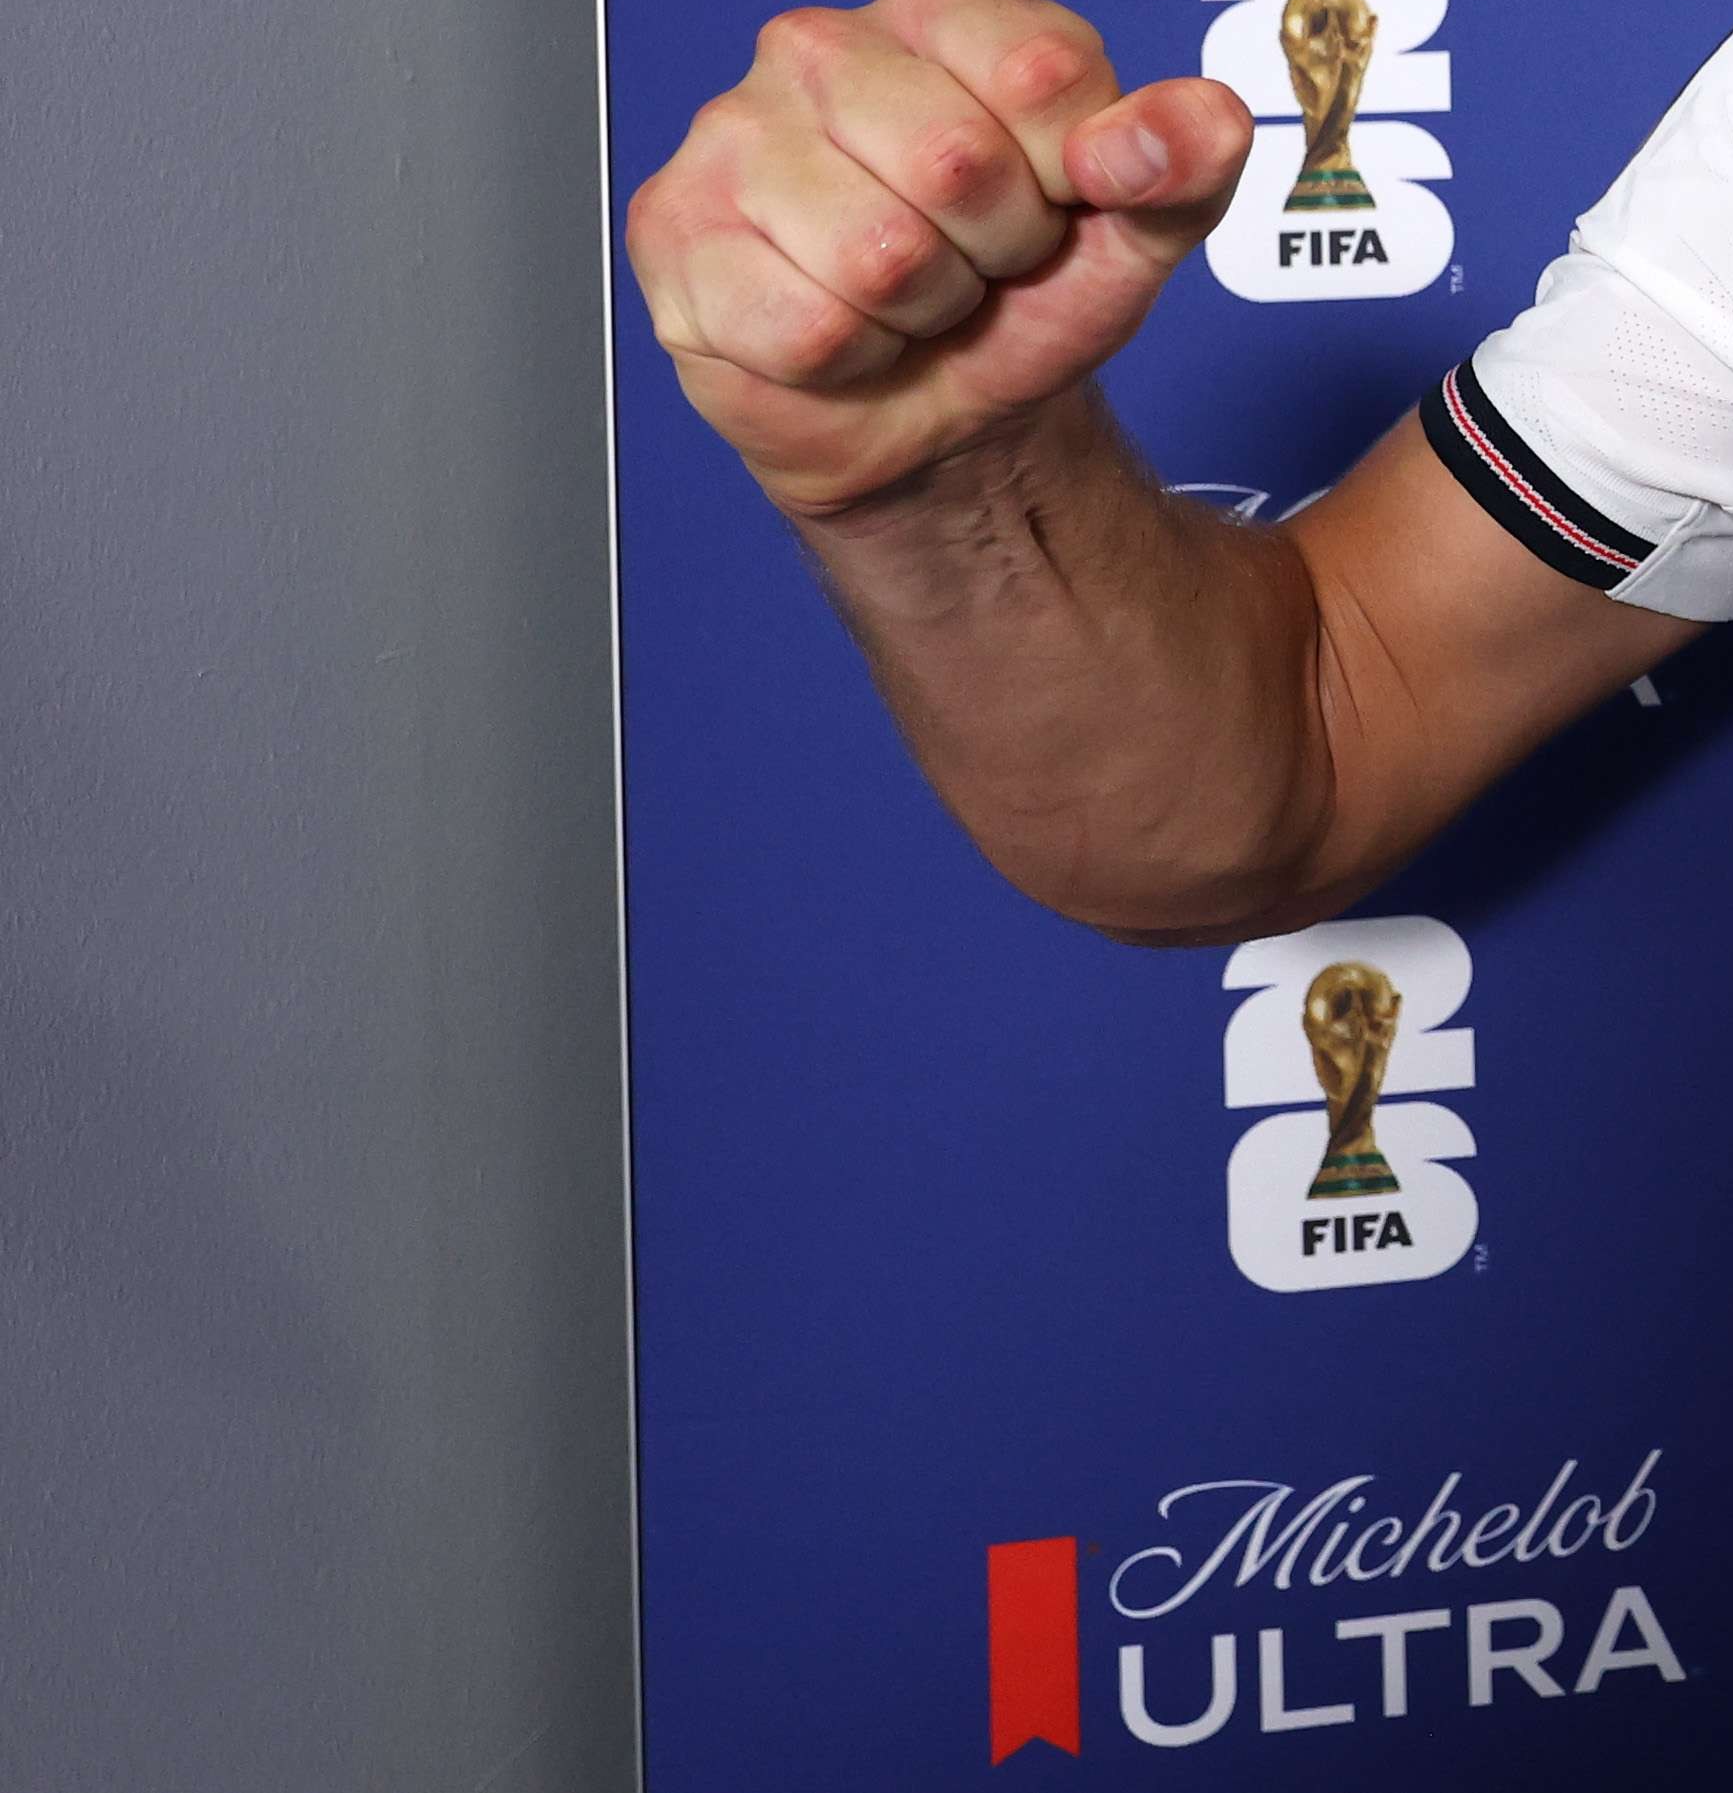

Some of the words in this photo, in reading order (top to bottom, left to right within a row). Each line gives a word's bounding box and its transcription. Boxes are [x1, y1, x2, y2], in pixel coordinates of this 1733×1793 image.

[1279, 229, 1388, 267] FIFA
[1302, 1211, 1413, 1257] FIFA
[1109, 1448, 1662, 1619] Michelob
[1118, 1586, 1686, 1748] ULTRA
